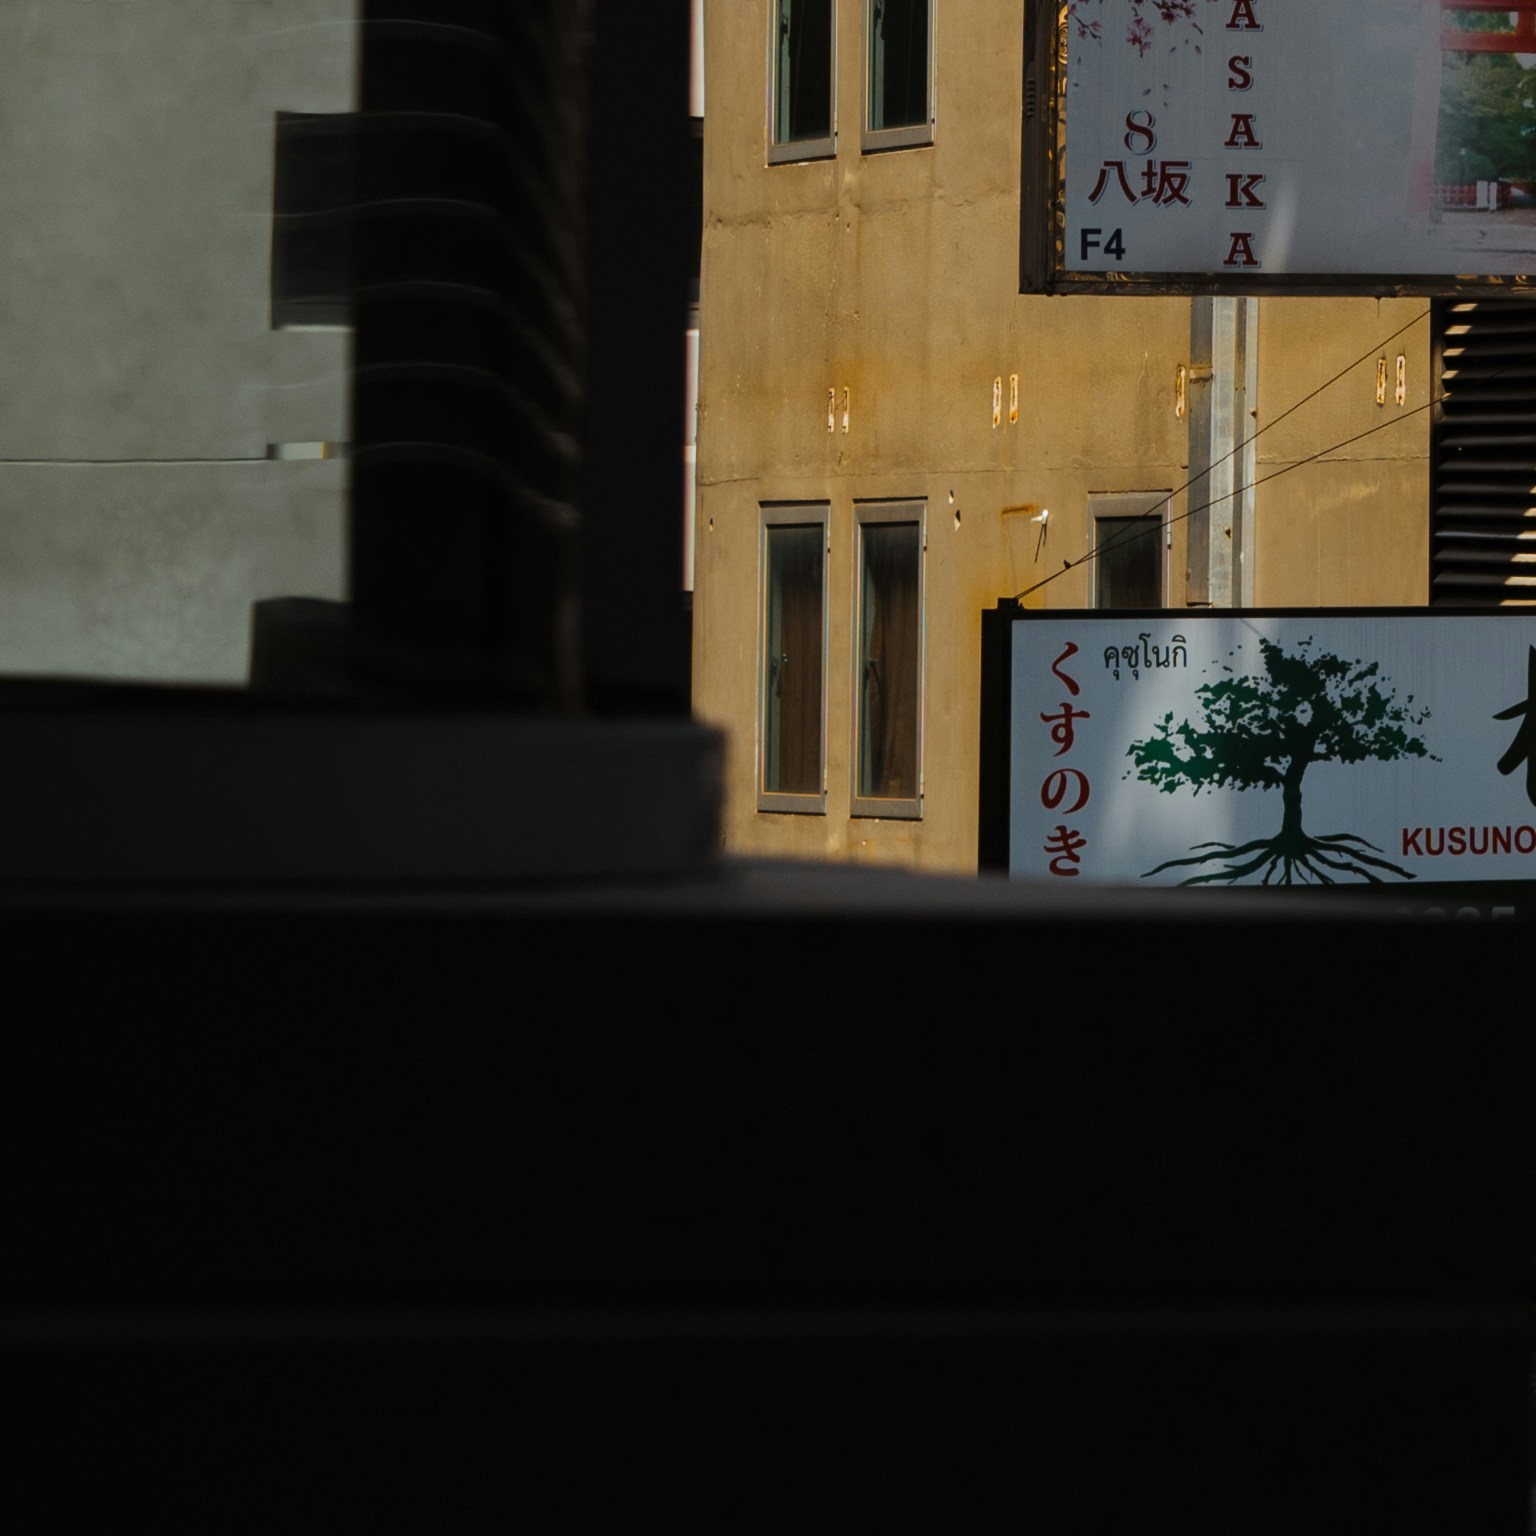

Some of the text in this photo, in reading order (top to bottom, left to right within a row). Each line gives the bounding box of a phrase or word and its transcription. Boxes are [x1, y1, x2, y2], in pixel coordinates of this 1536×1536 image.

[1088, 159, 1193, 207] 八坂
[1080, 227, 1127, 262] F4
[1040, 640, 1091, 878] くすのき
